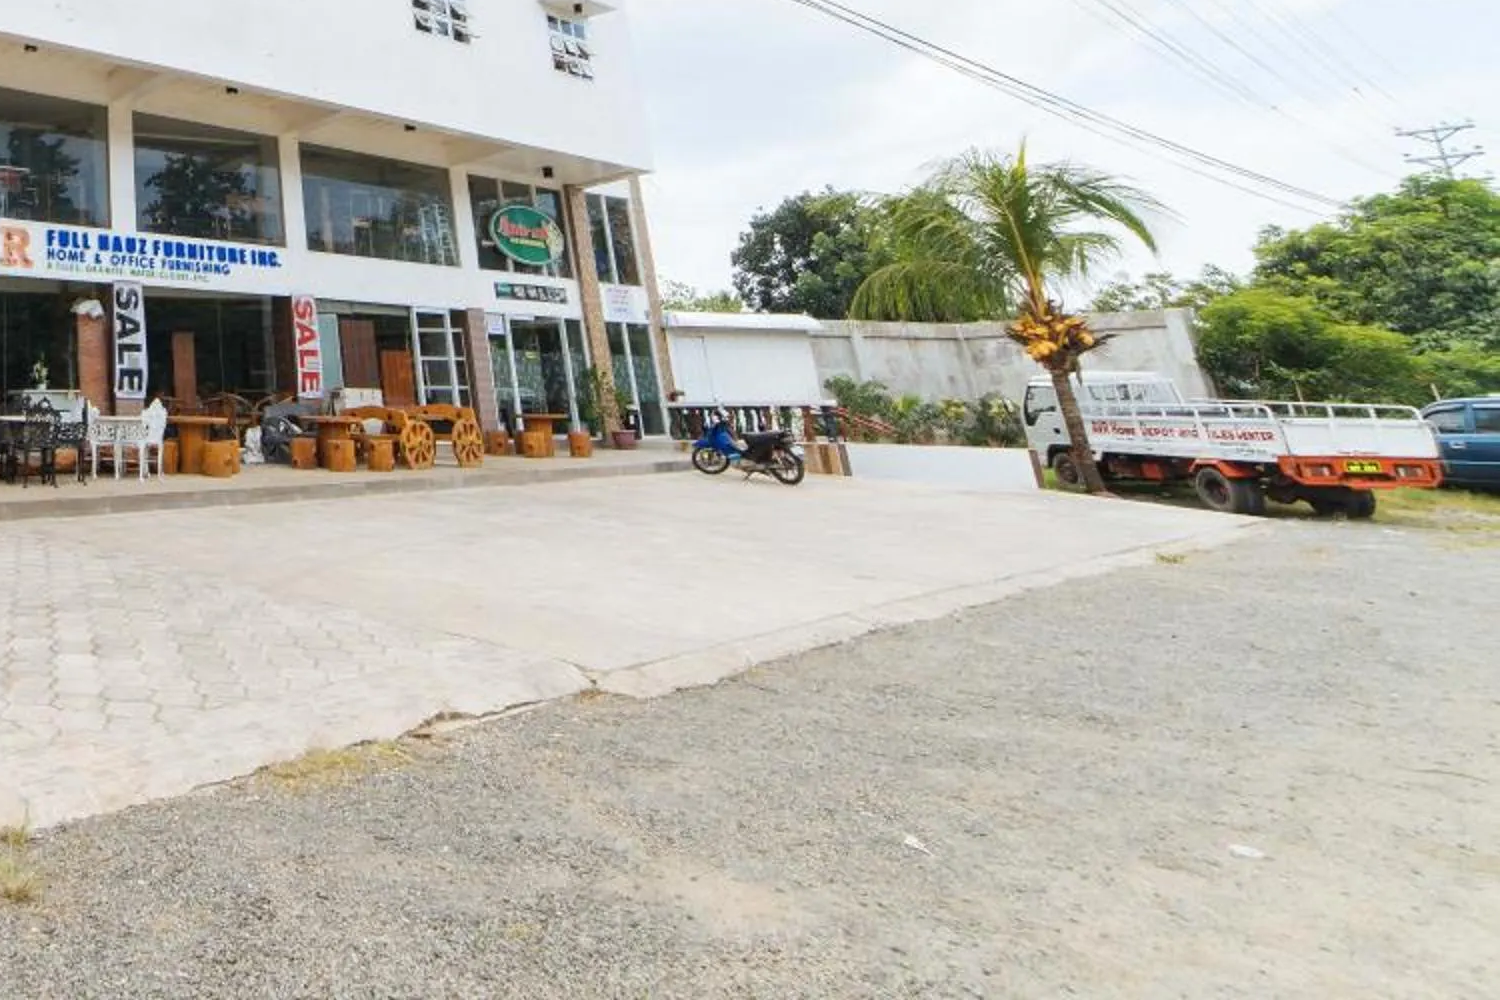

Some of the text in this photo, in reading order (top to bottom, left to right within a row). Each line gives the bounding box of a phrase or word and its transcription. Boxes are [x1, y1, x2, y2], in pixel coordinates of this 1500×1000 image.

[46, 229, 91, 250] FULL
[98, 234, 148, 254] HAUZ
[153, 238, 248, 264] FURNITURE
[46, 247, 86, 263] HOME
[110, 254, 156, 270] OFFICE
[161, 258, 231, 276] FURNISHING
[115, 287, 144, 391] SALE
[294, 299, 320, 392] SALE
